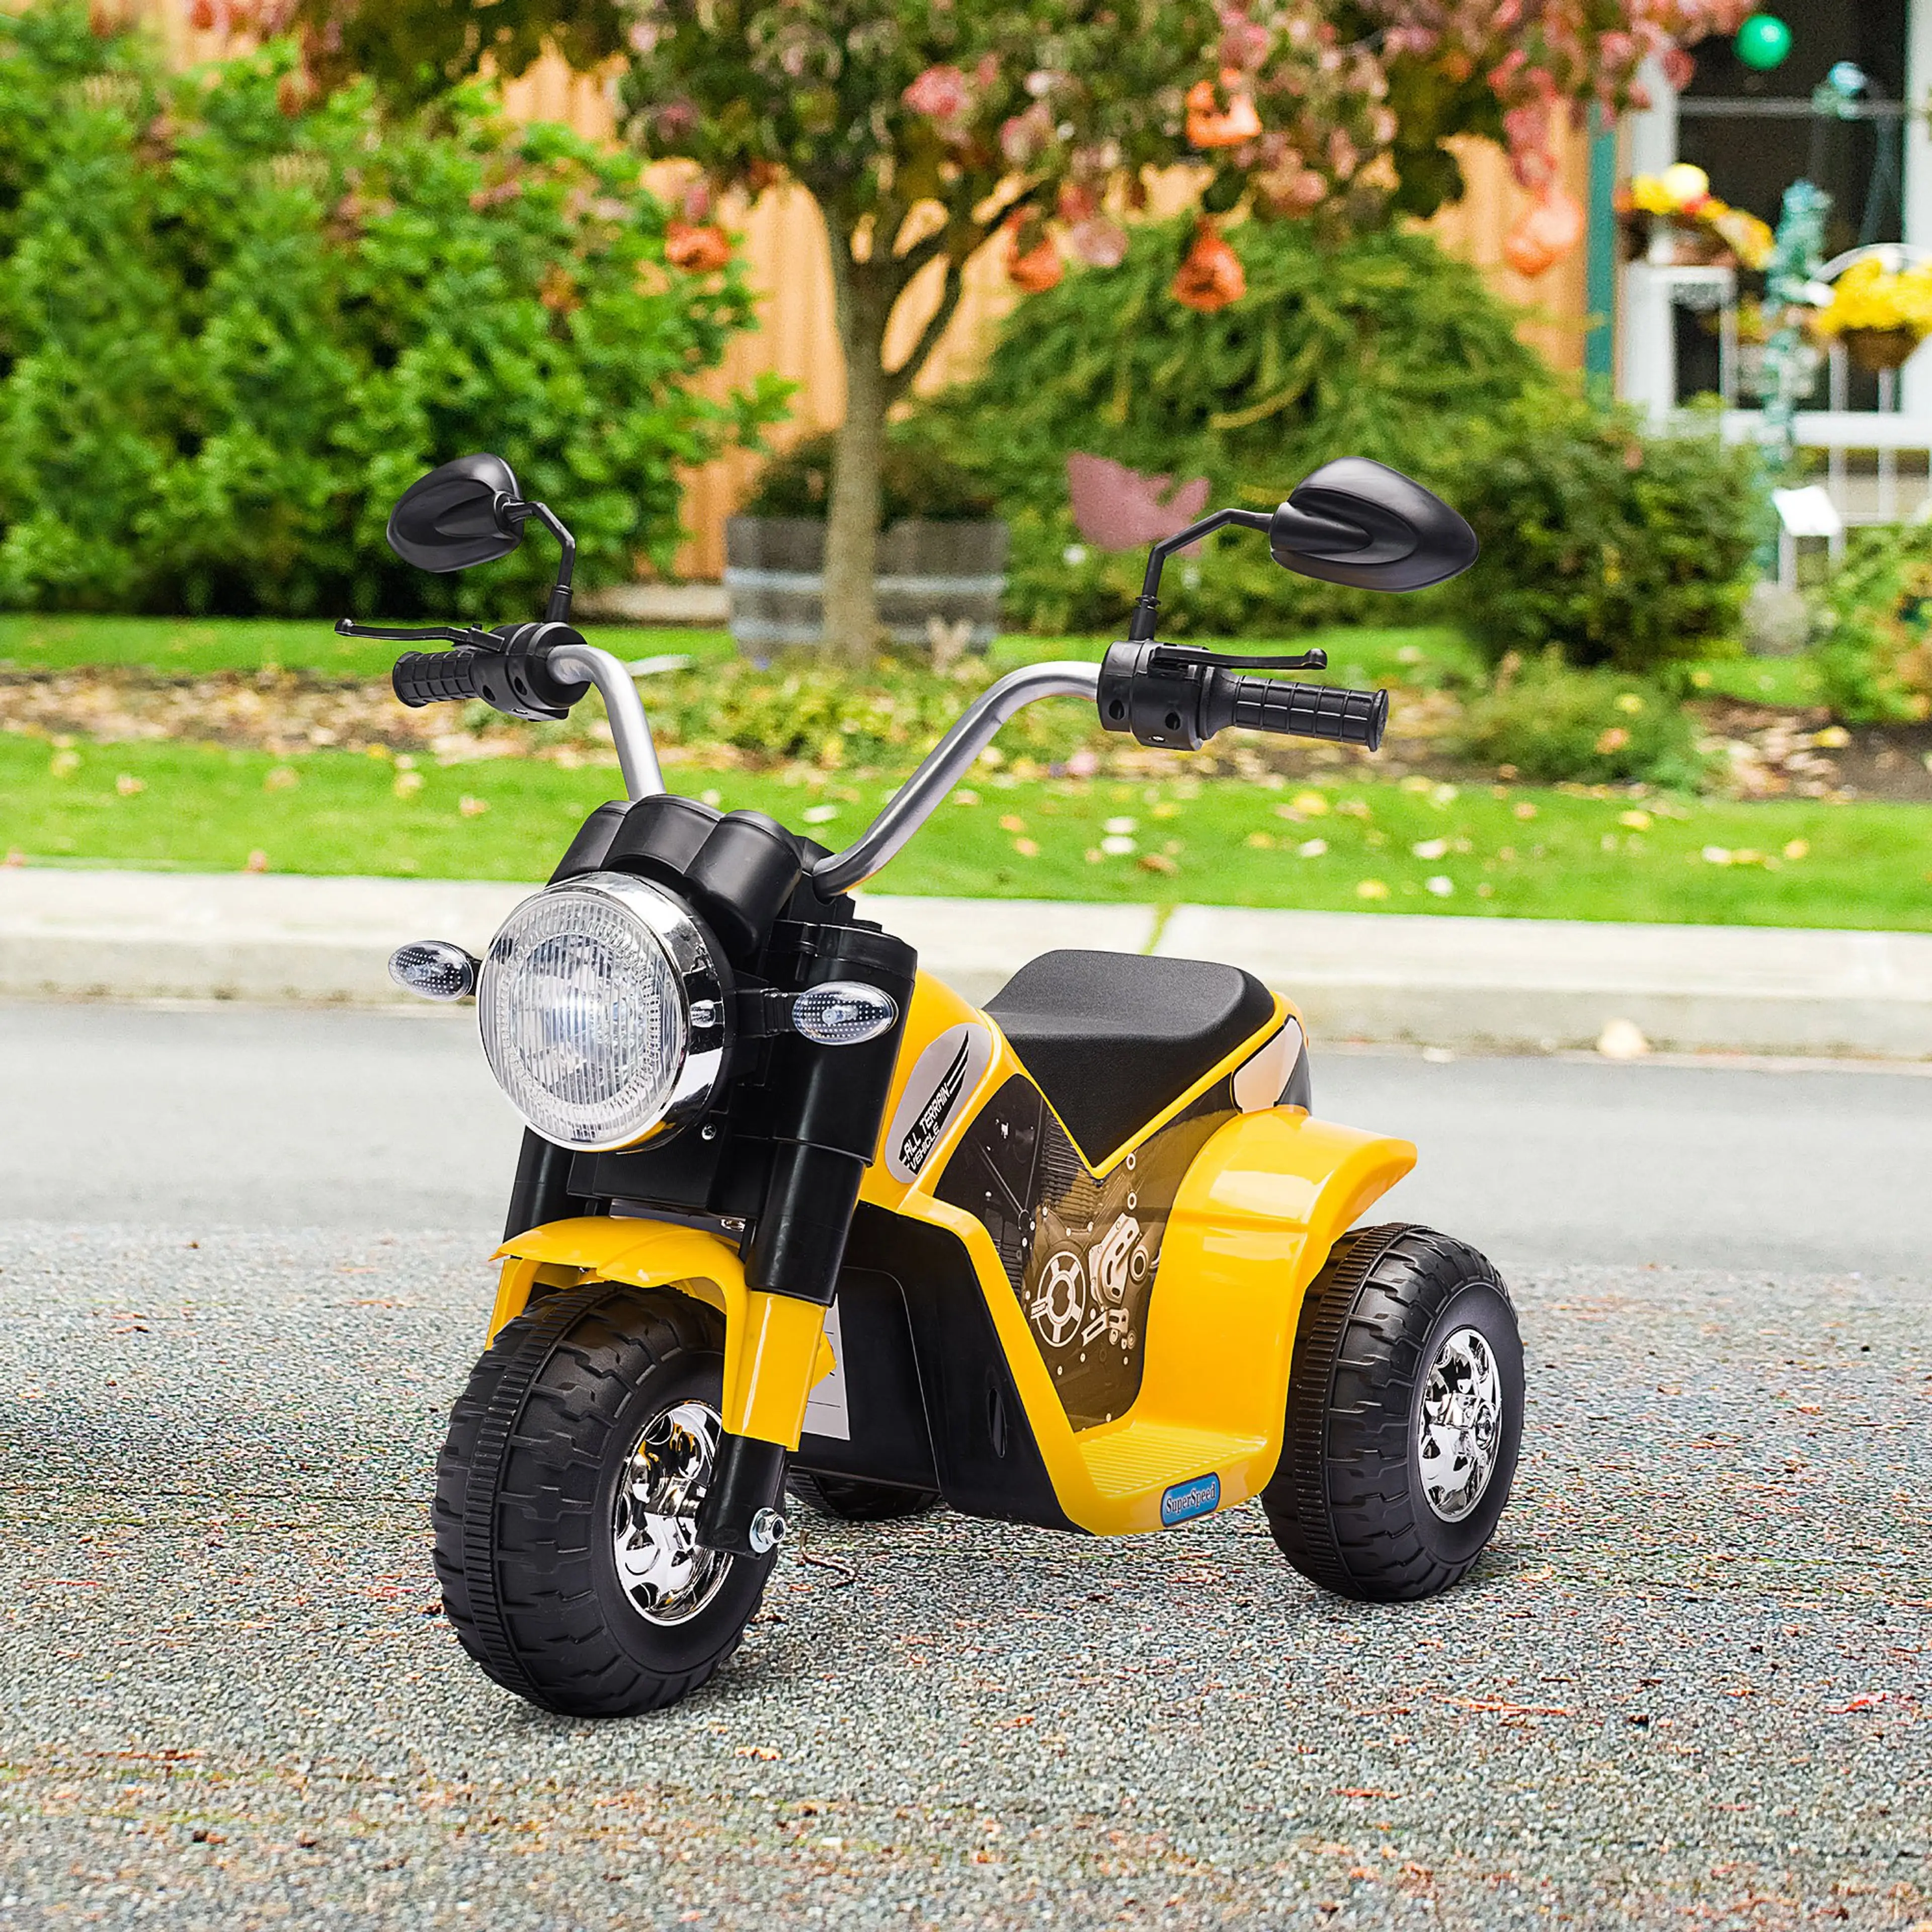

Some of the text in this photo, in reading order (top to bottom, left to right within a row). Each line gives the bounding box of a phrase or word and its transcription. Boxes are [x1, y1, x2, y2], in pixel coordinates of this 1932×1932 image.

[904, 1083, 950, 1160] ALL TERRAIN
[910, 1122, 939, 1170] VEHICLE
[1166, 1482, 1216, 1514] SuperSpeed
